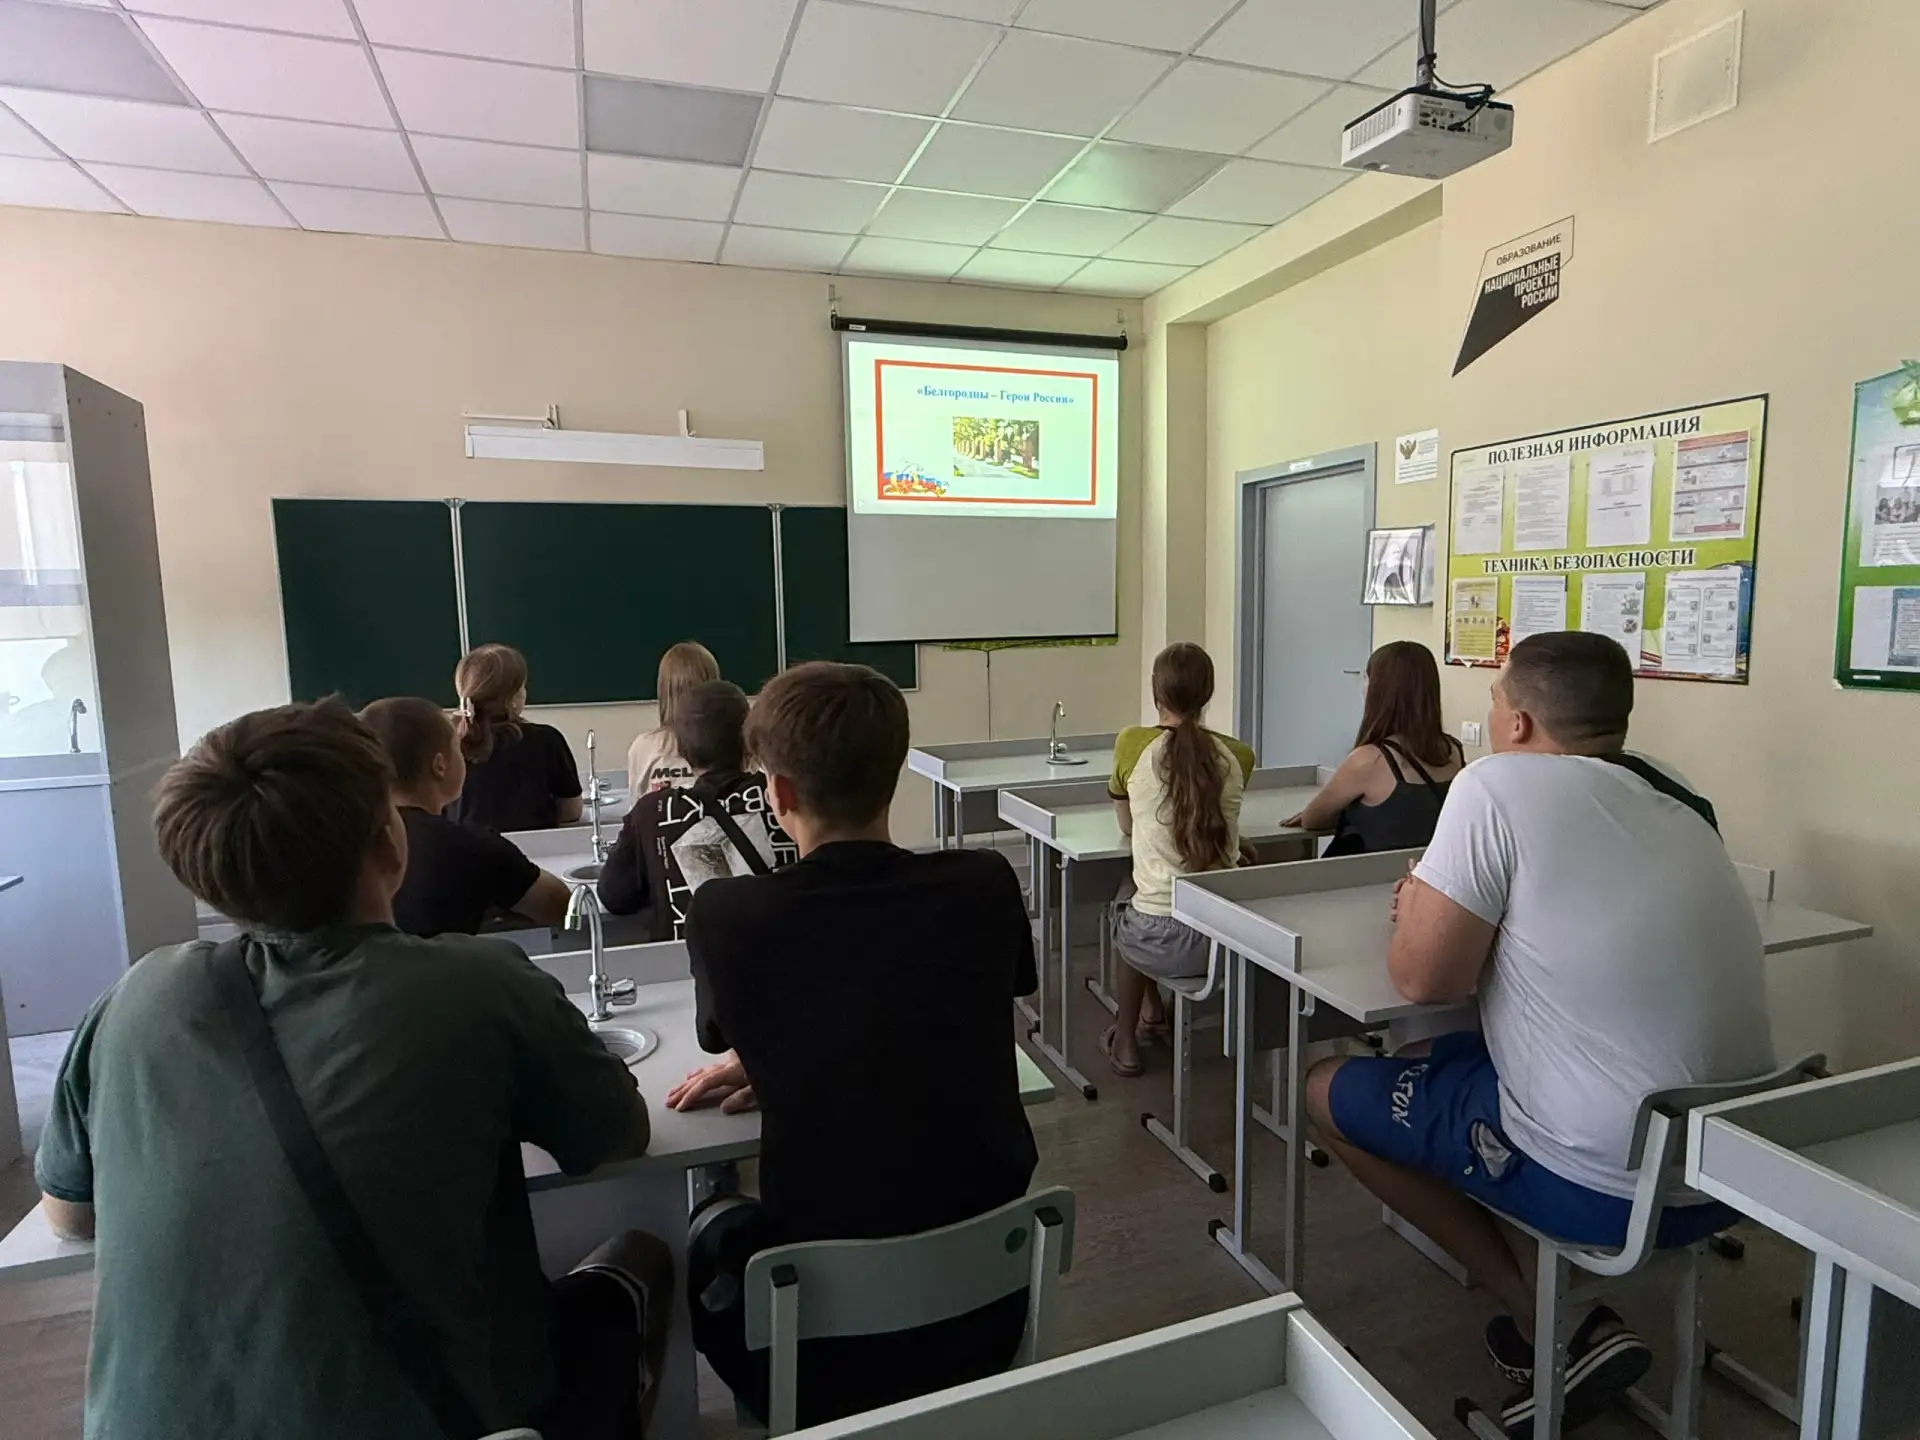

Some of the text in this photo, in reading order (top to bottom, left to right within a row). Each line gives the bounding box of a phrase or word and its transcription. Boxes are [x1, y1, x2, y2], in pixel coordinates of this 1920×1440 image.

[1496, 233, 1562, 266] ОБРАЗОВАНИЕ
[1484, 255, 1559, 295] НАЦИОНАЛЬНЫЕ
[1514, 269, 1559, 297] ПРОЕКТЫ
[1521, 284, 1558, 309] РОССИИ
[1000, 390, 1031, 403] Герои
[1488, 415, 1700, 465] ПОЛЕЗНАЯ ИНФОРМАЦИЯ
[1484, 549, 1694, 573] ТЕХНИКА БЕЗОПАСНОСТИ
